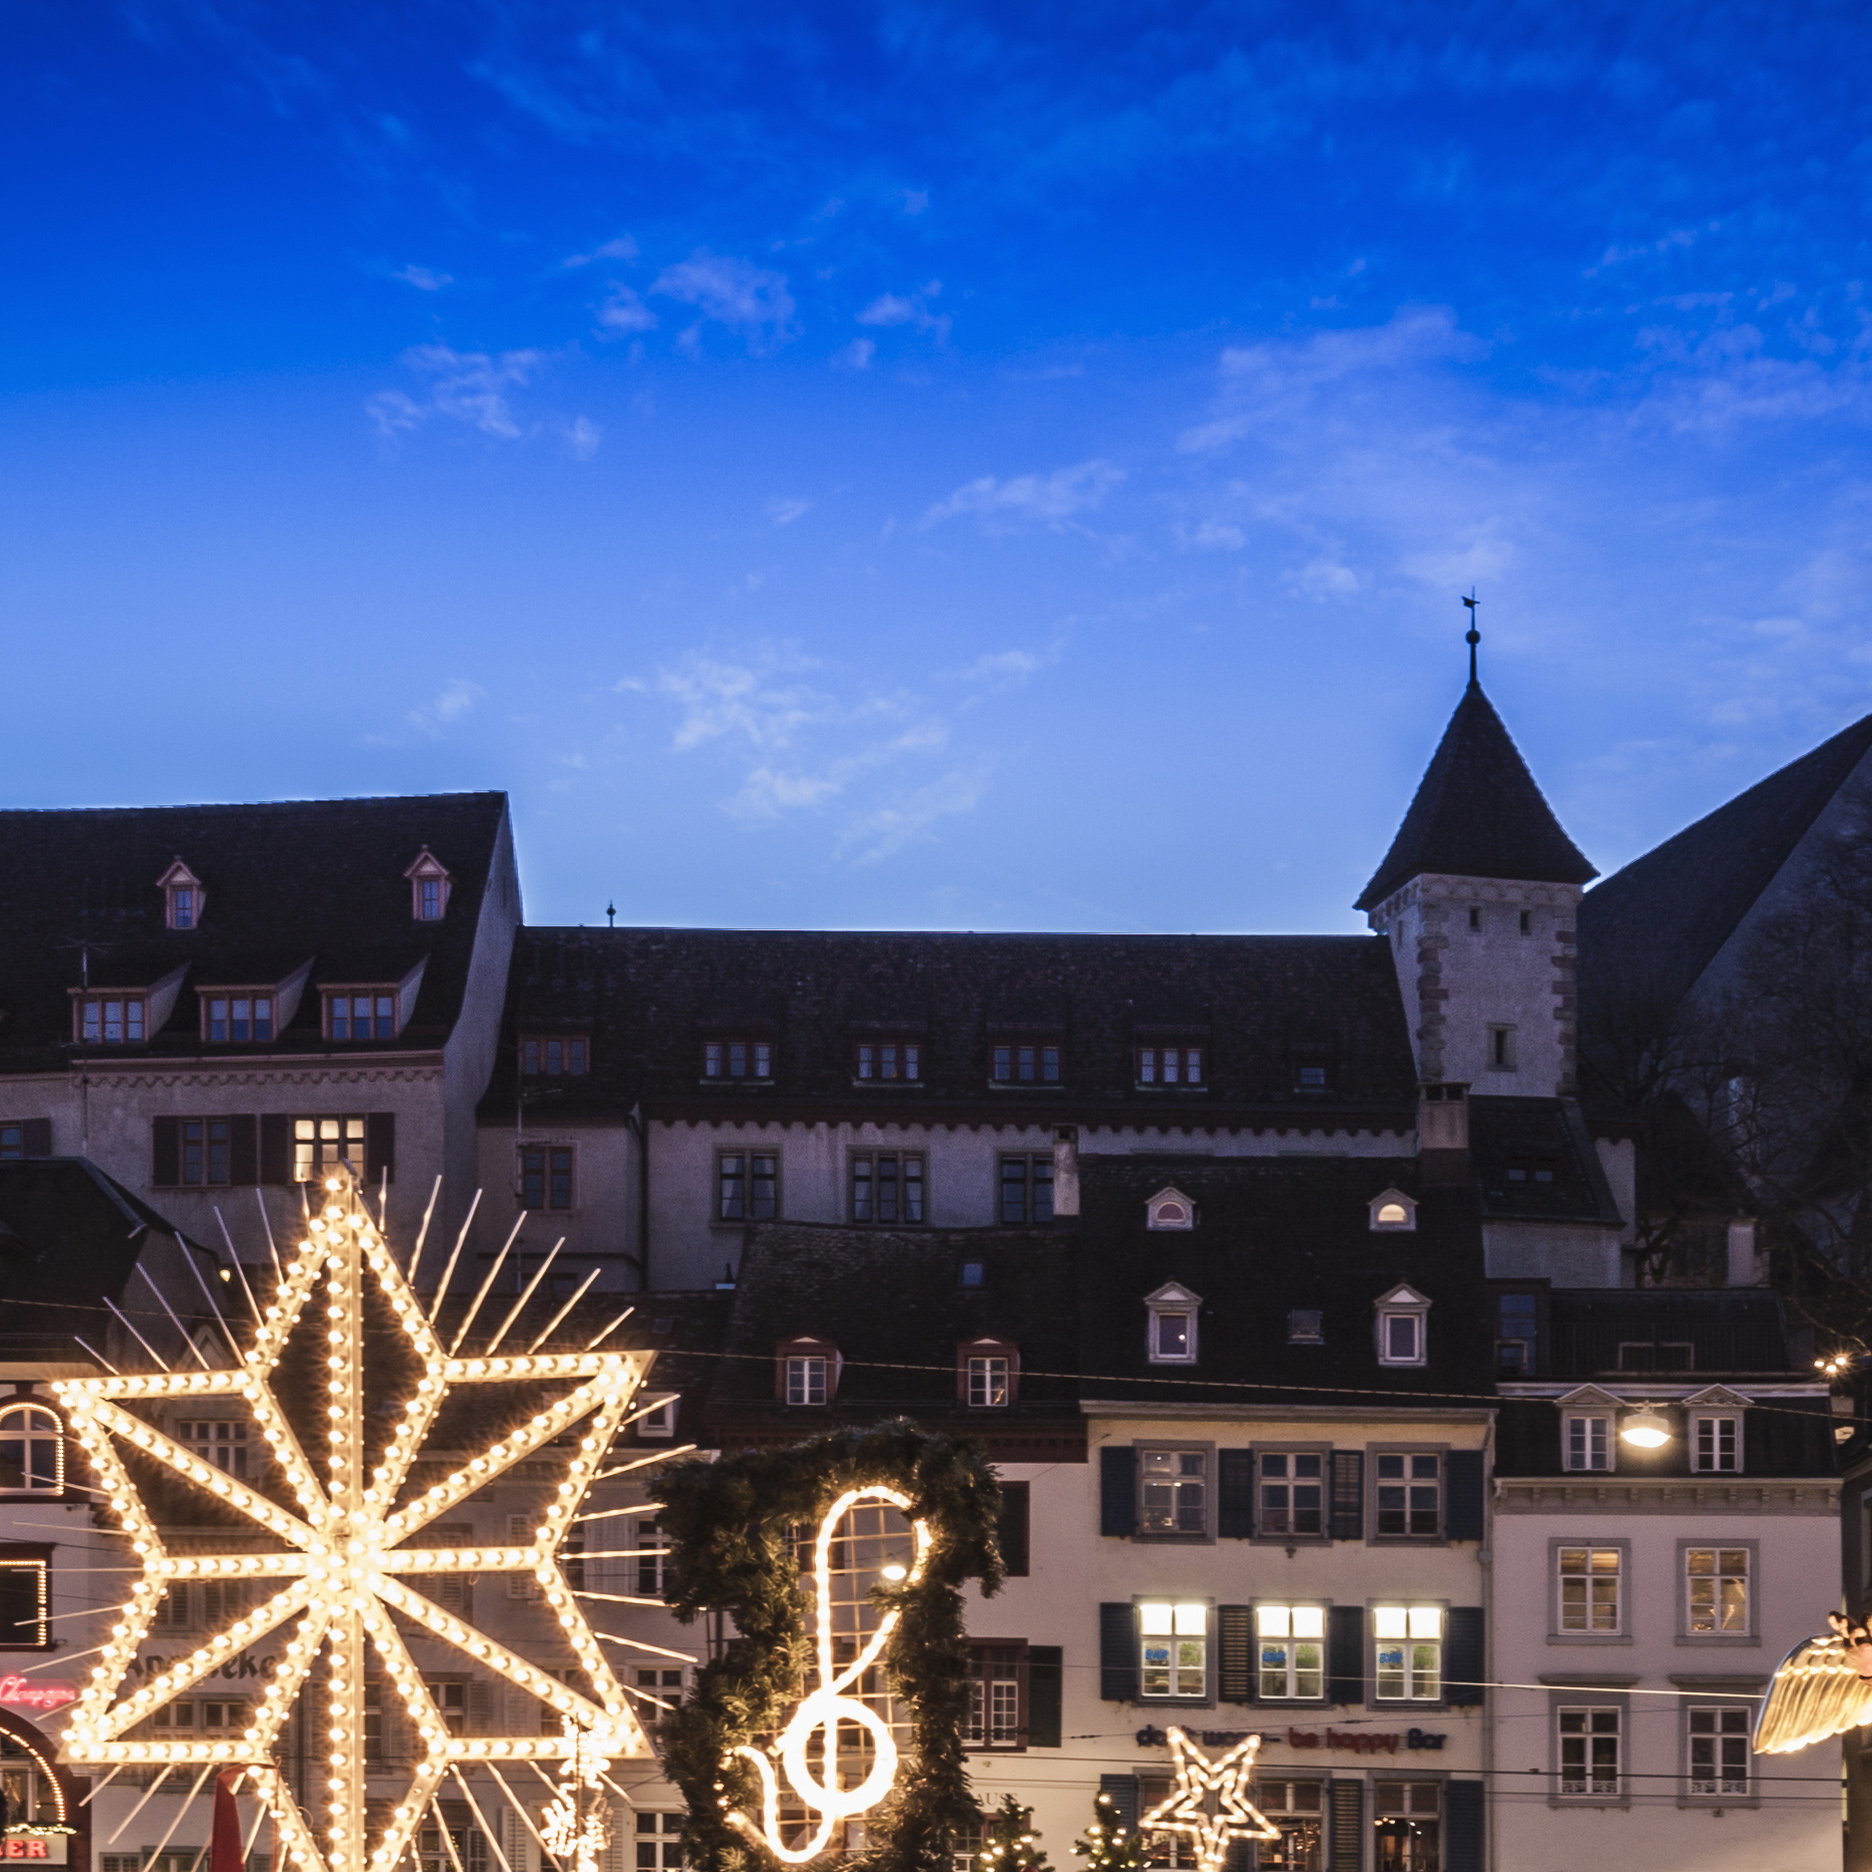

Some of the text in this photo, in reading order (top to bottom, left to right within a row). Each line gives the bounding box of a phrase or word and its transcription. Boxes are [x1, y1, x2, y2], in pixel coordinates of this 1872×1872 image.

[1289, 1727, 1318, 1749] be
[1327, 1727, 1399, 1754] happy
[1408, 1728, 1447, 1750] Bar
